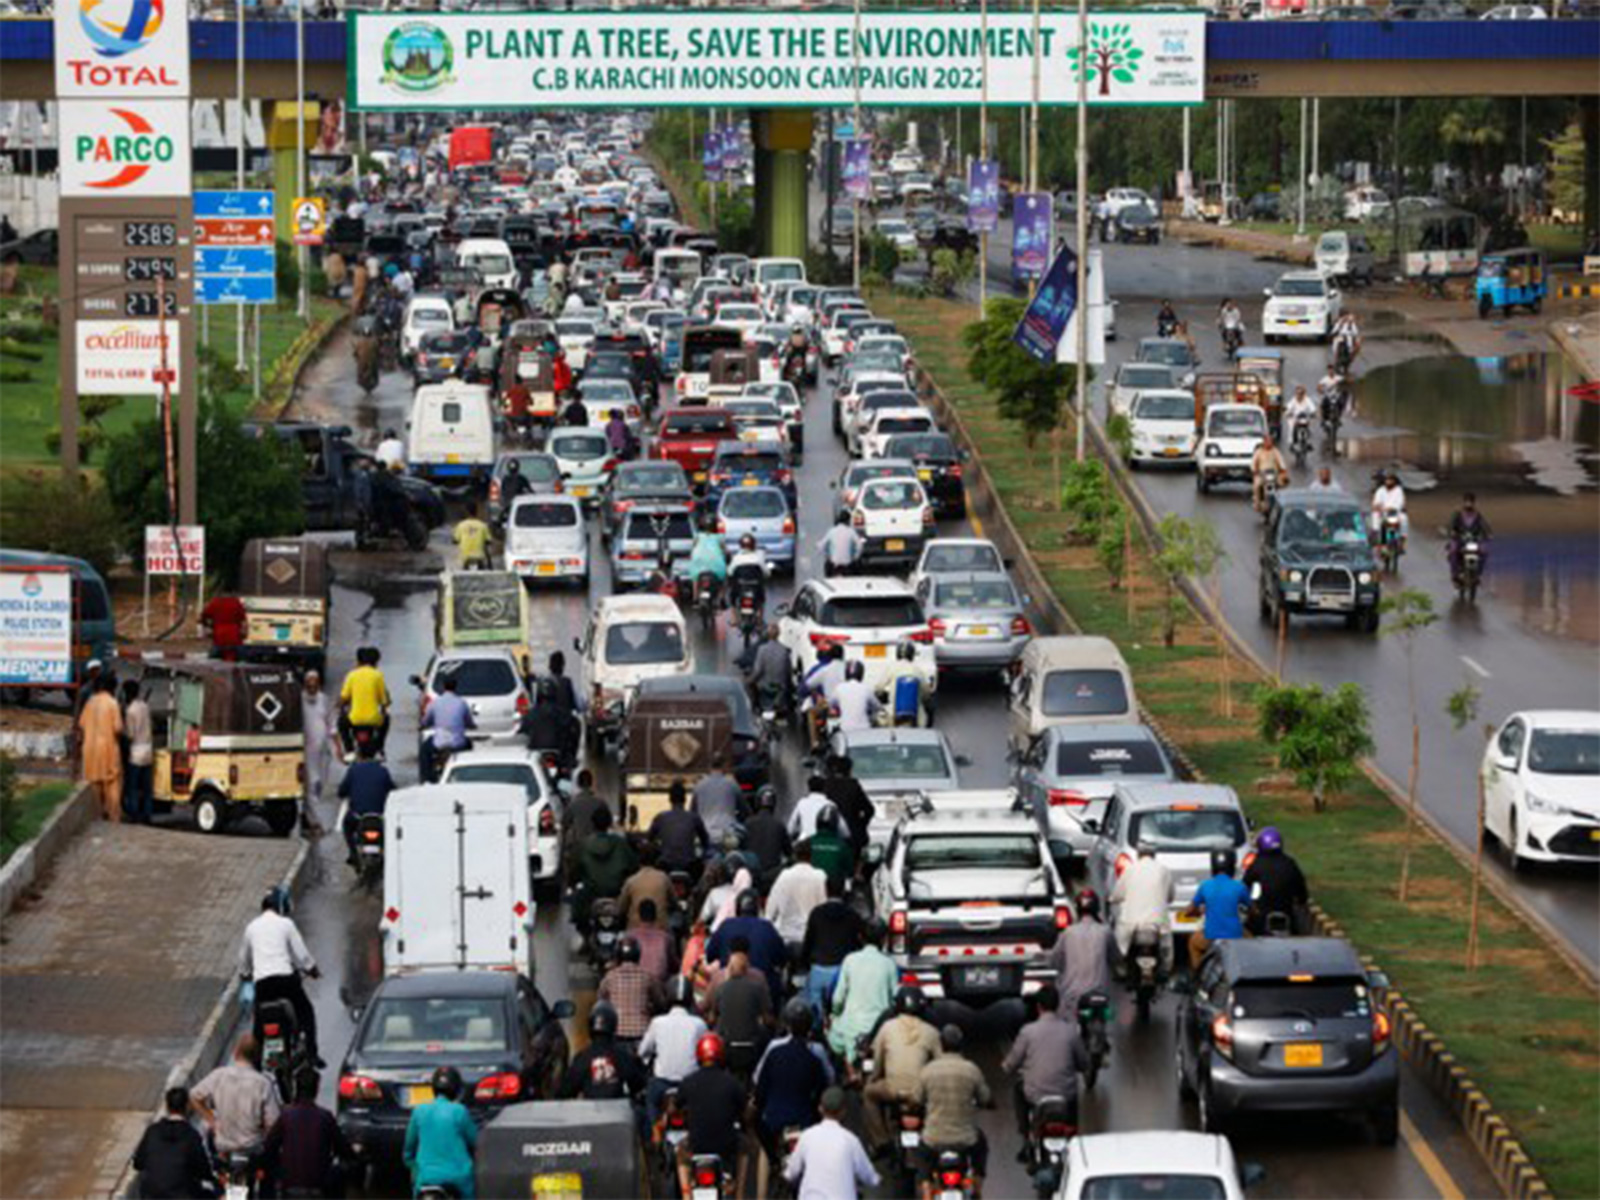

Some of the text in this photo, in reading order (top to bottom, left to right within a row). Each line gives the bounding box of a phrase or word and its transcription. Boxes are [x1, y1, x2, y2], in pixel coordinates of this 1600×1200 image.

[465, 28, 1056, 61] PLANT A TREE, SAVE THE ENVIRONMENT
[532, 66, 983, 90] C.B KARACHI MONSOON CAMPAIGN 2022
[77, 136, 174, 162] PARCO
